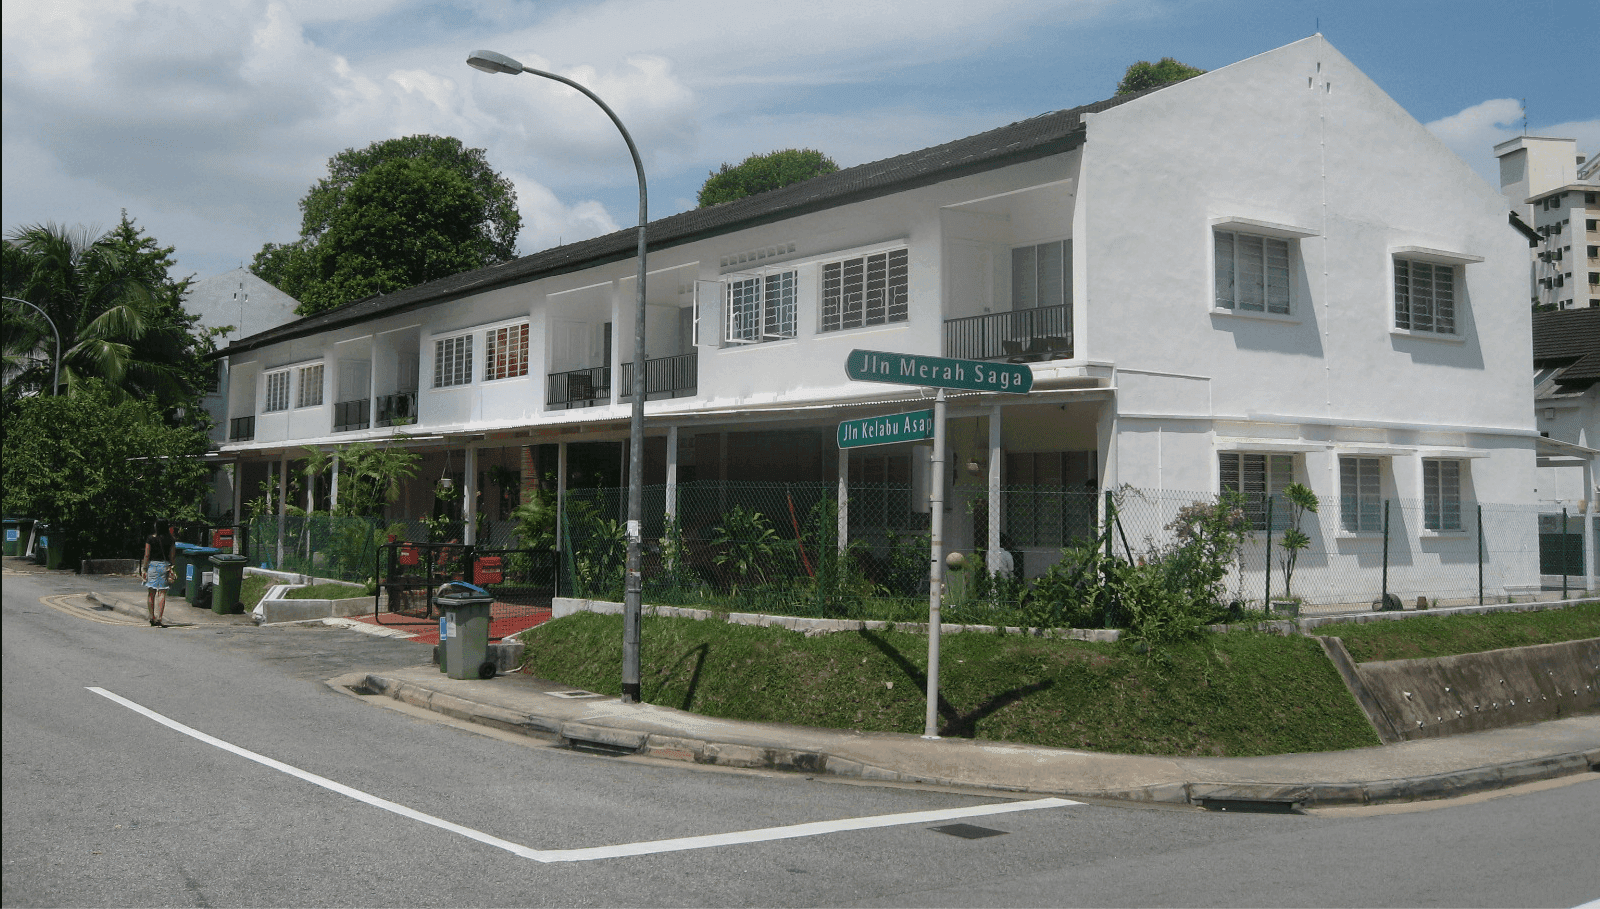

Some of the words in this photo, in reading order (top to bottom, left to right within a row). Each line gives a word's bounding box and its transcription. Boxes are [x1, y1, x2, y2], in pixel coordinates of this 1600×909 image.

[860, 354, 890, 375] Jln
[900, 358, 965, 381] Merah
[974, 364, 1022, 389] Saga
[843, 424, 858, 441] Jln
[862, 418, 899, 439] Kelabu
[903, 416, 932, 435] Asap
